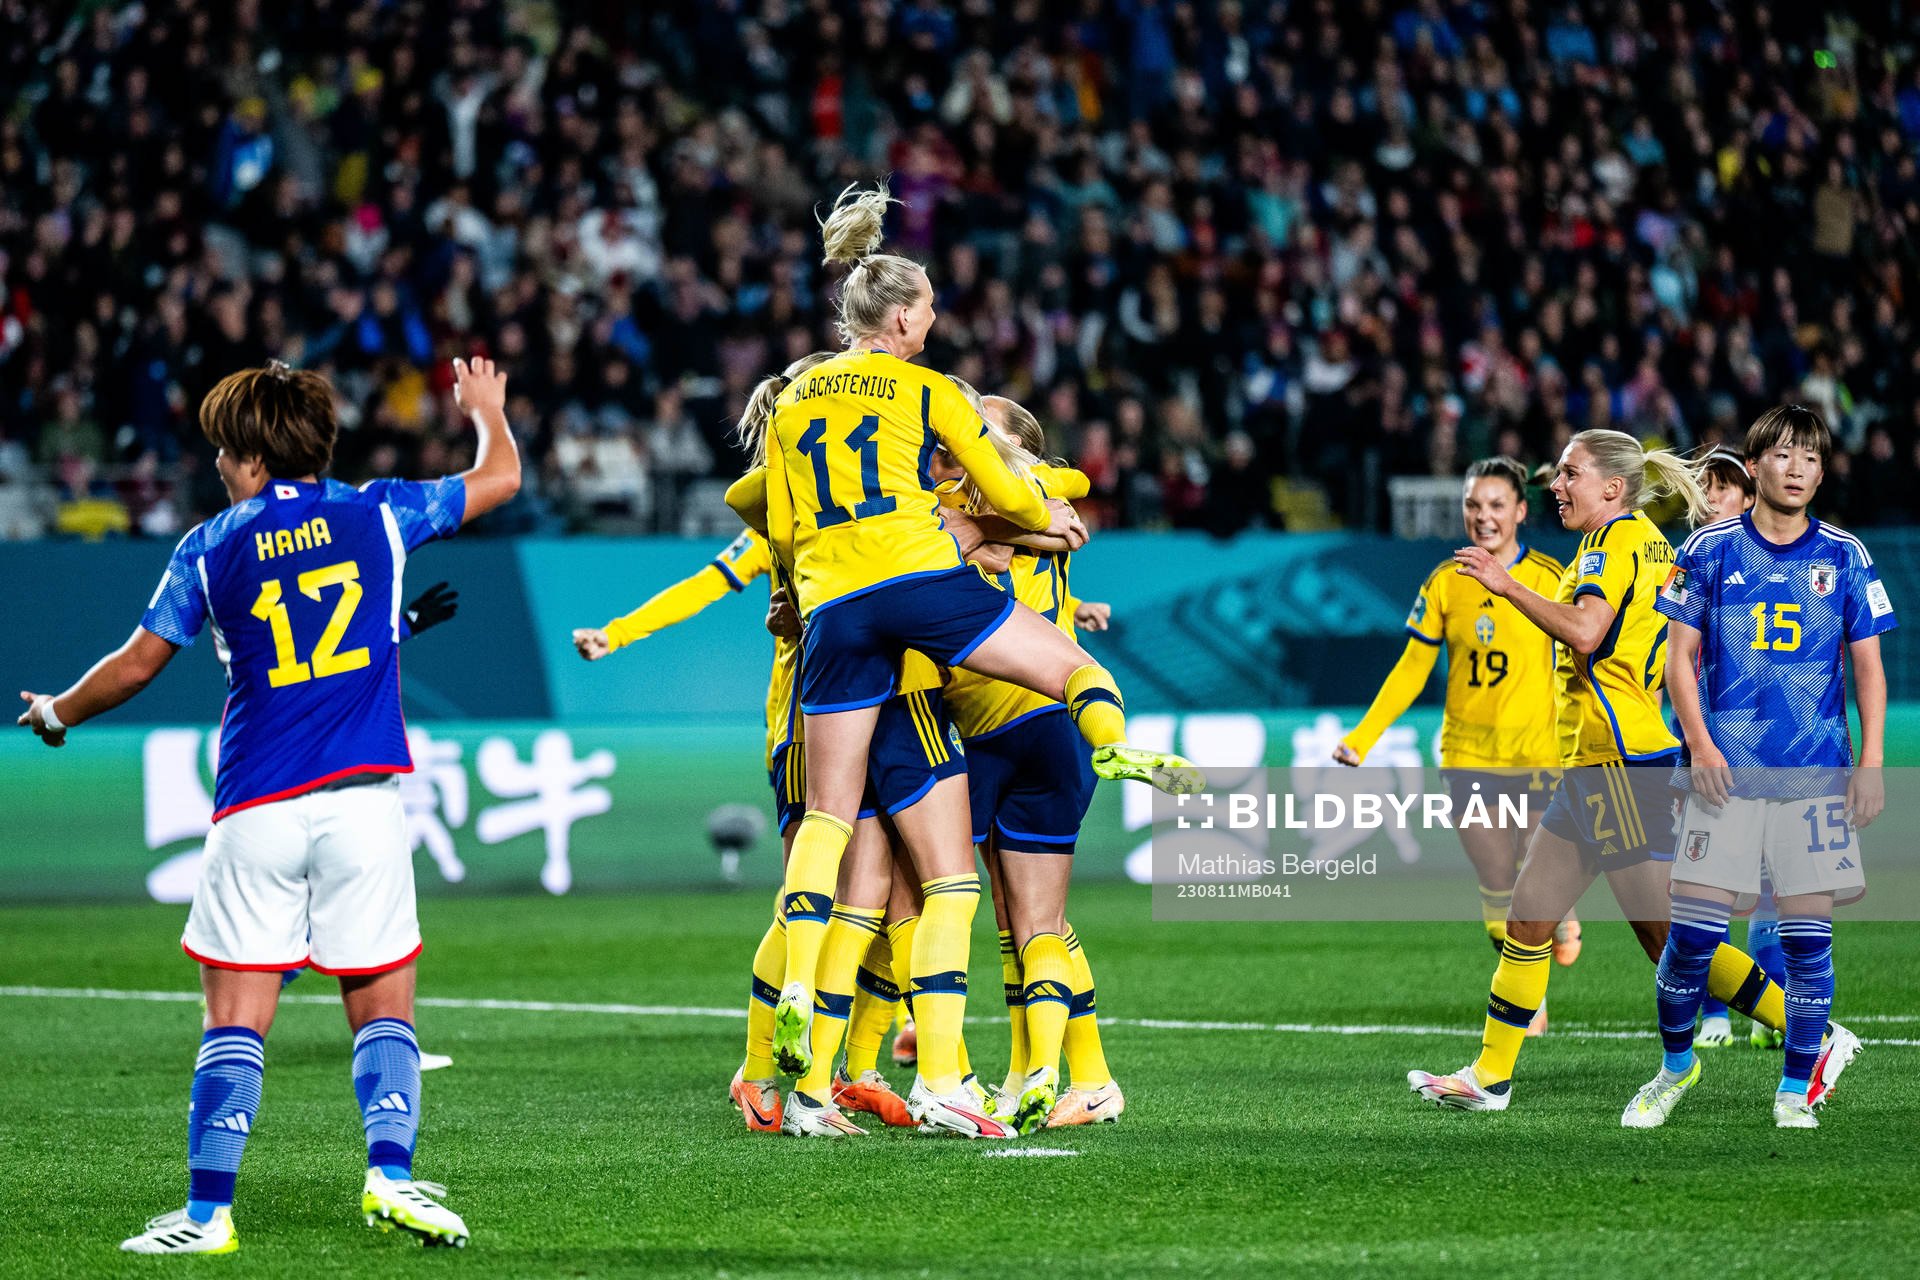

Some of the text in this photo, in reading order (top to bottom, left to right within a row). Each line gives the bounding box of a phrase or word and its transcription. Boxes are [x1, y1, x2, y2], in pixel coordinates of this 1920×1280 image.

[795, 373, 897, 402] BLACKSTENIUS
[796, 415, 897, 529] 11
[255, 517, 332, 561] HANA
[1644, 540, 1675, 563] ANDERS
[251, 560, 370, 688] 12
[1750, 601, 1802, 651] 15
[1468, 649, 1508, 688] 19
[1586, 793, 1616, 840] 2
[1802, 801, 1850, 853] 15
